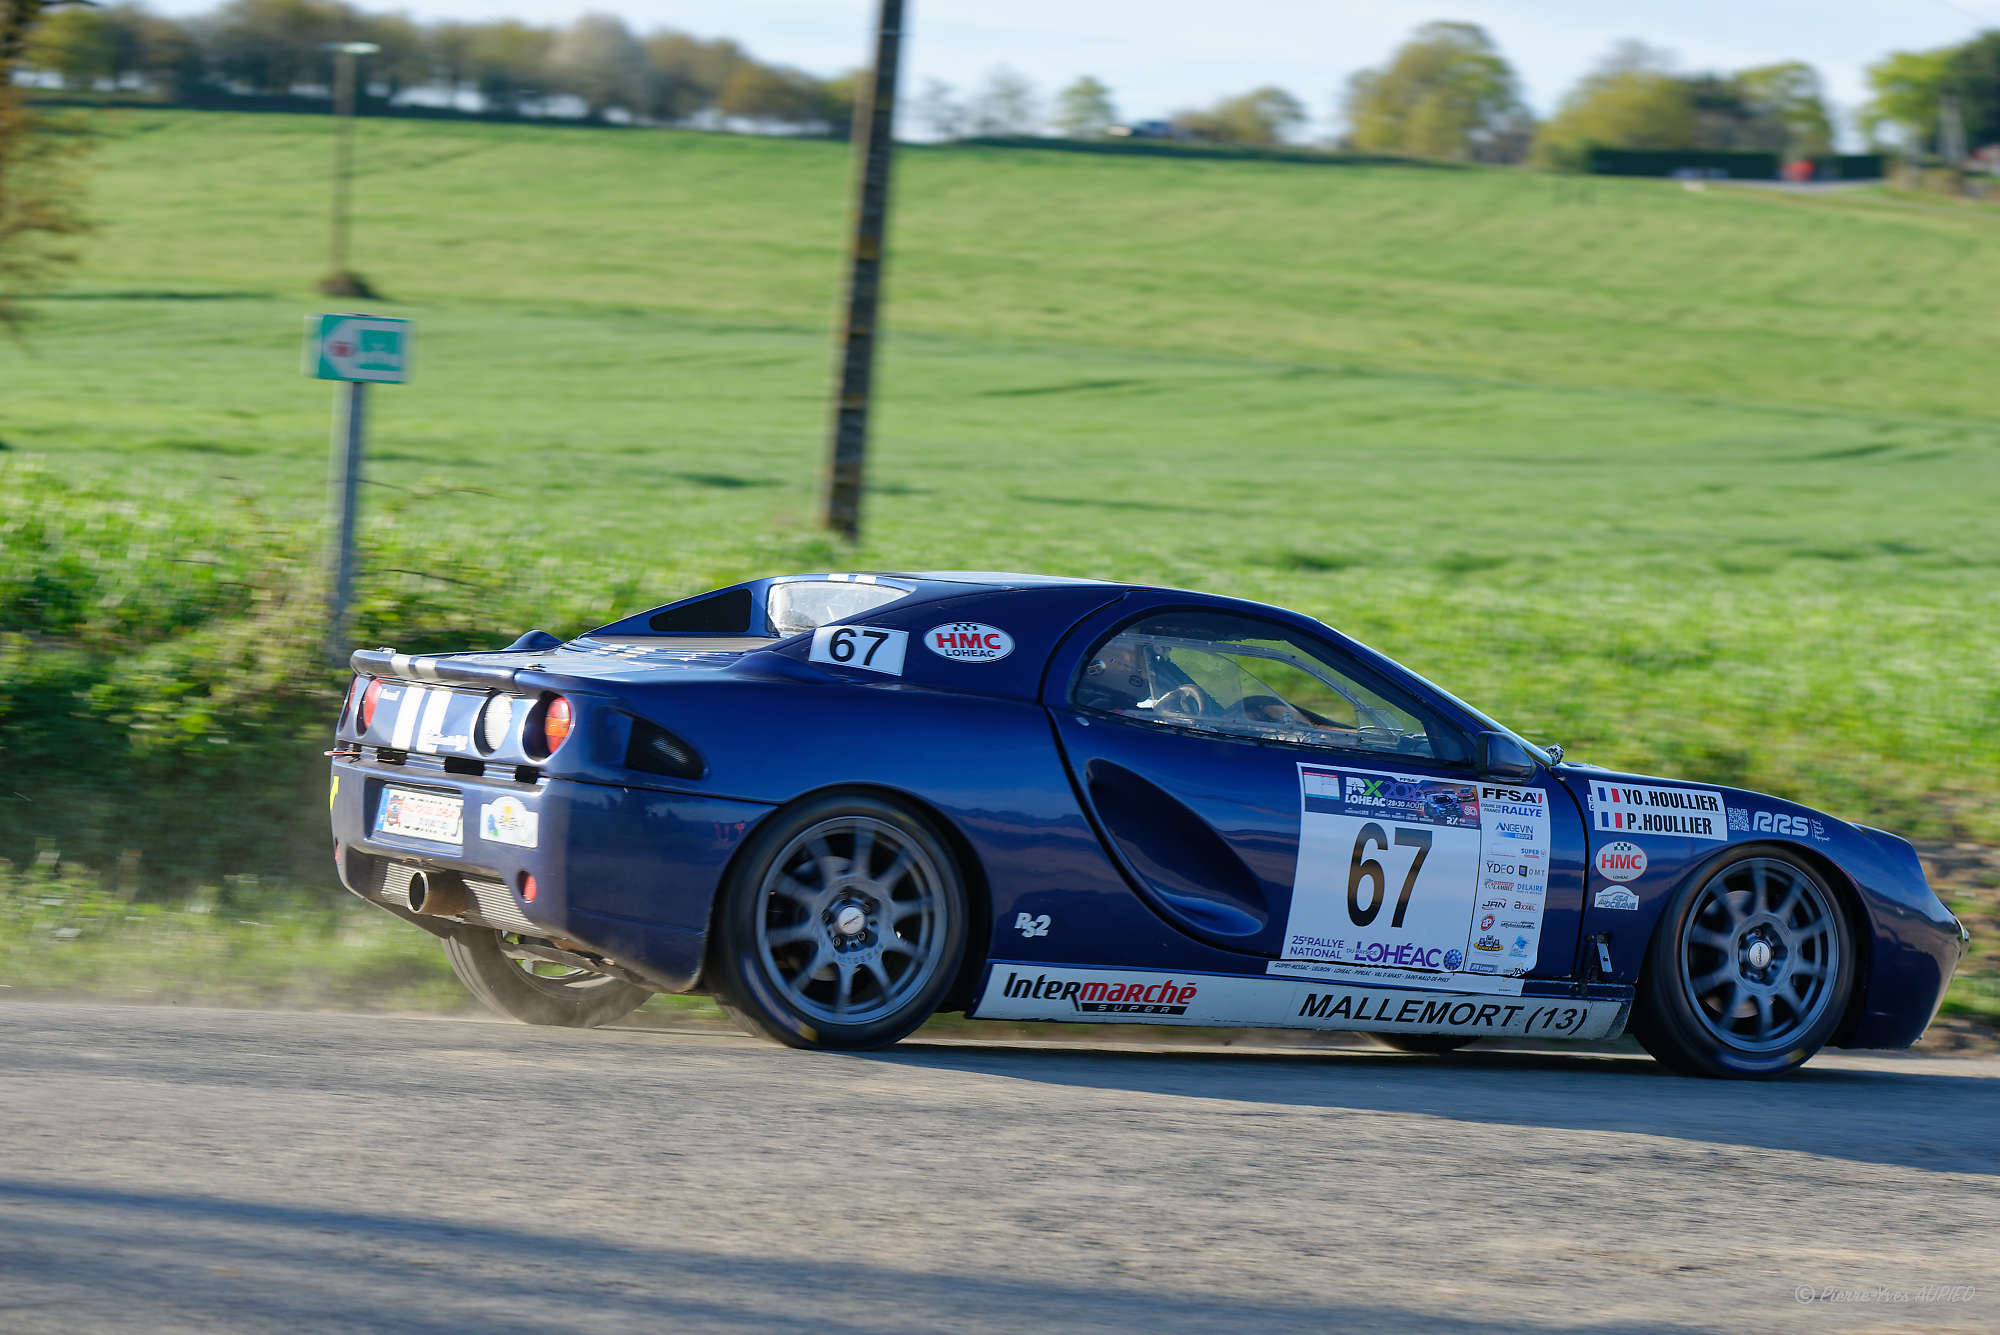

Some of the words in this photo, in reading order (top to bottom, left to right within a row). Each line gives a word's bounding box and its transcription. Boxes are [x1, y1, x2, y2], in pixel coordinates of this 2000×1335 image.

[829, 628, 889, 666] 67
[936, 633, 1001, 650] HMC
[945, 648, 995, 658] LOHEAC
[1345, 794, 1386, 807] LOHEAC
[1482, 787, 1537, 804] FFSA
[1622, 788, 1719, 812] YO.HOULLIER
[1502, 805, 1543, 818] RALLYE
[1496, 822, 1534, 834] ANGEVIN
[1627, 812, 1713, 835] P.HOULLIER
[1752, 811, 1809, 837] RRS
[1601, 854, 1643, 870] HMC
[1347, 822, 1433, 928] 67
[1290, 946, 1342, 959] NATIONAL
[1354, 940, 1442, 968] LOHÉAC
[1298, 993, 1524, 1028] MALLEMORT
[1523, 1005, 1588, 1036] (13)
